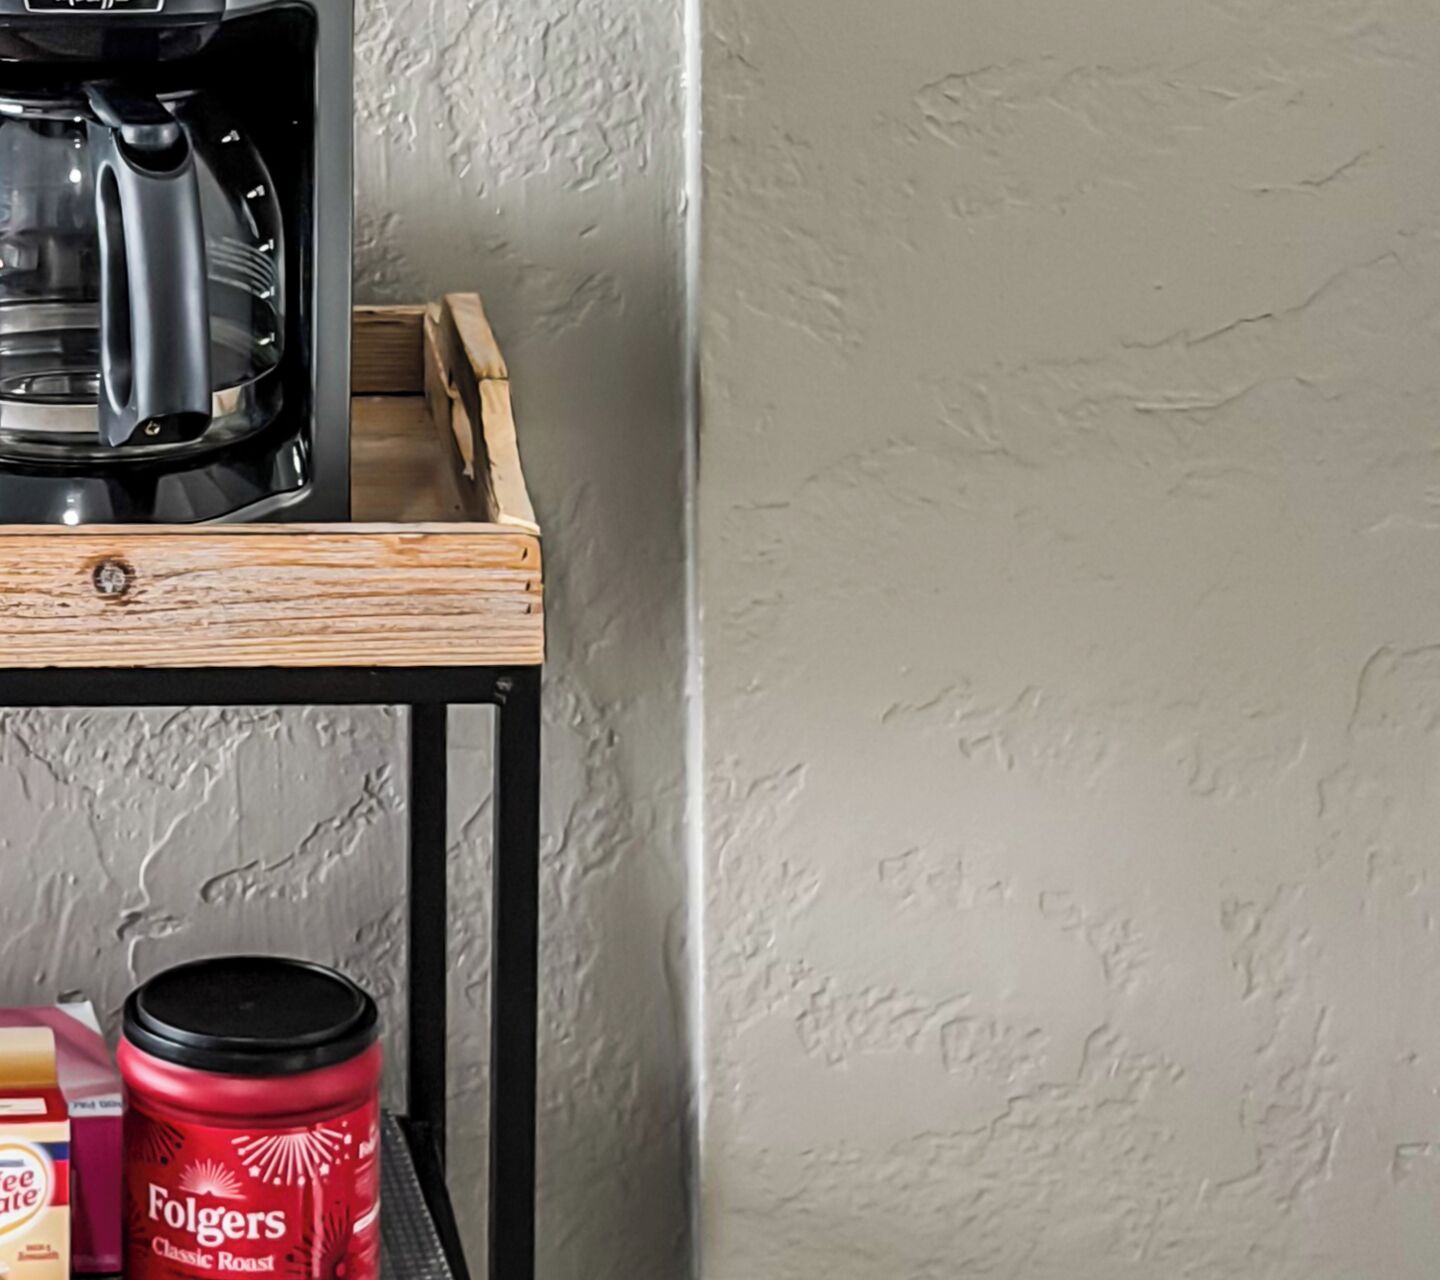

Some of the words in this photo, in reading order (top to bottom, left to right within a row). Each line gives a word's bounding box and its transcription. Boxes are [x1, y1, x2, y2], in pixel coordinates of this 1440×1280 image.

[148, 1182, 286, 1248] Folgers
[151, 1236, 213, 1269] Classic
[217, 1252, 275, 1272] Roast
